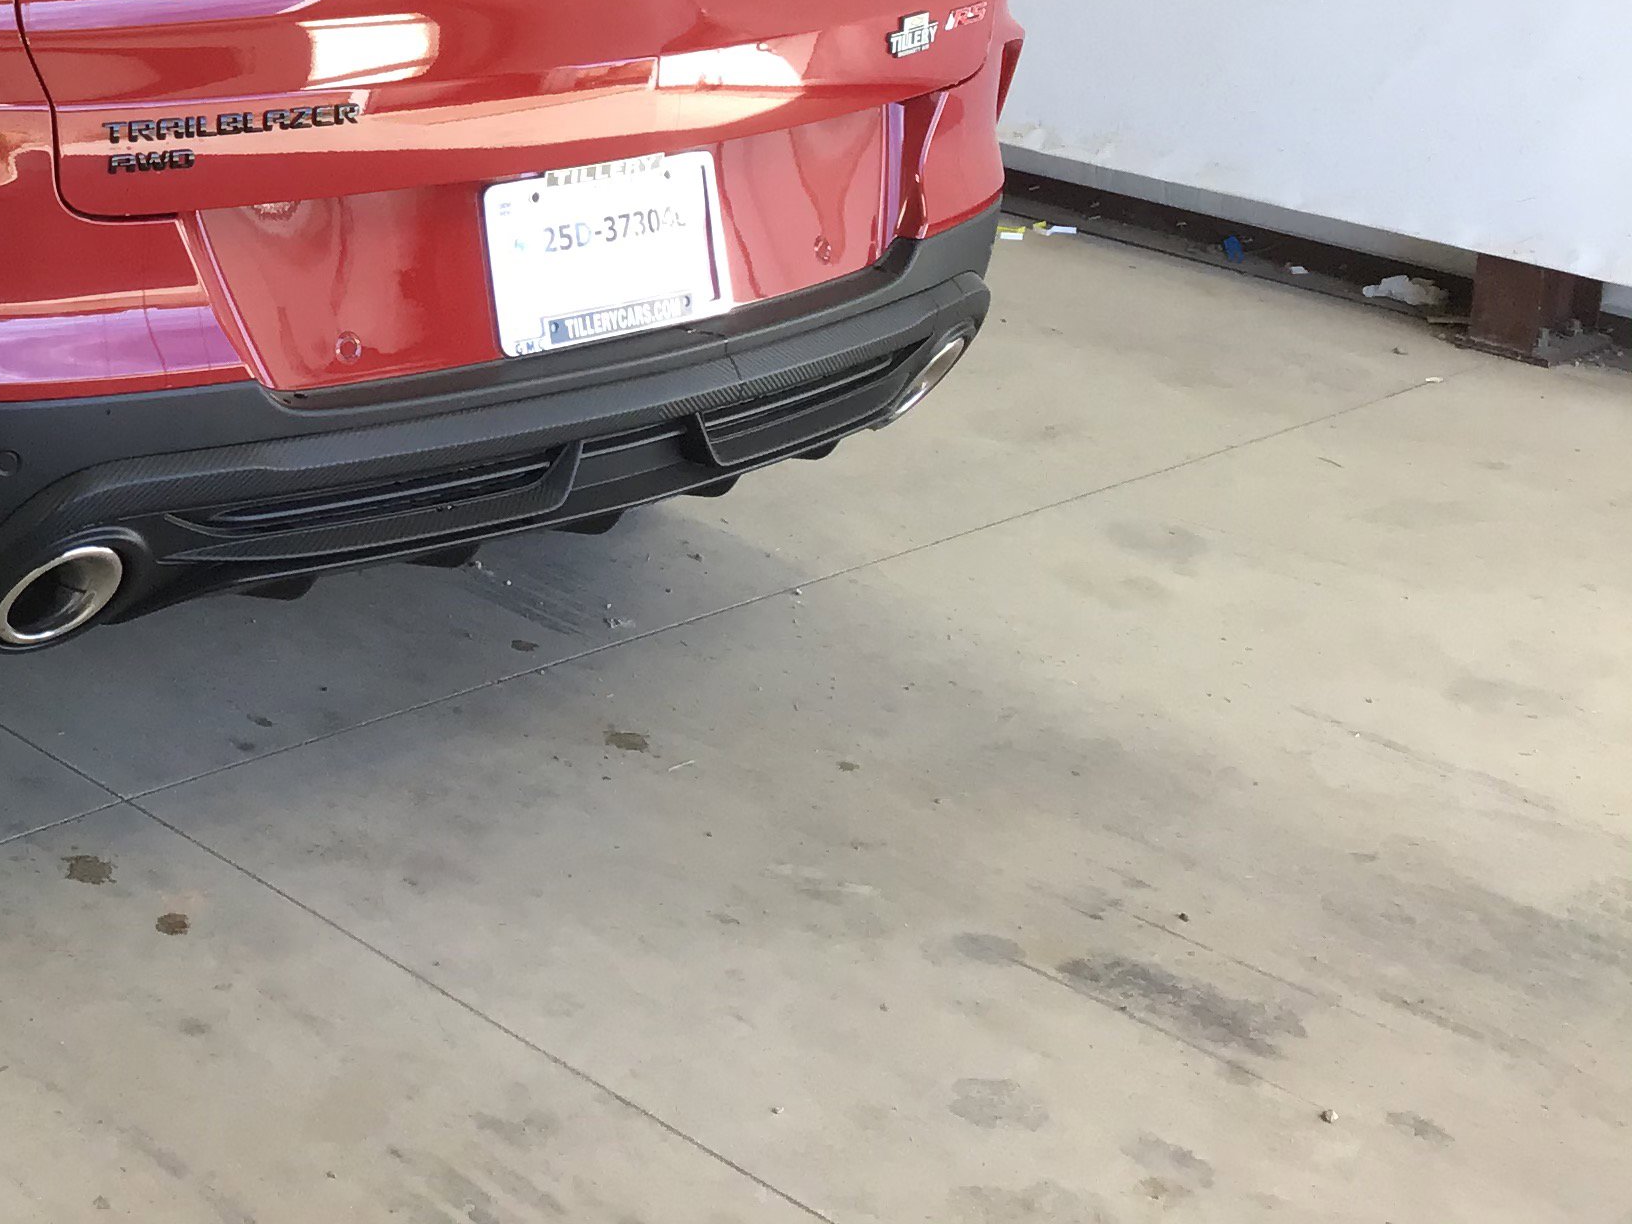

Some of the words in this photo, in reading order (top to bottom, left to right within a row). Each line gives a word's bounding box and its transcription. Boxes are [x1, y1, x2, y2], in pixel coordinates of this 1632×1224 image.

[890, 24, 938, 53] TILLERY
[102, 103, 360, 143] TRAILBLAZER
[108, 149, 195, 174] AWD
[565, 297, 682, 339] TILLERYCARS.COM
